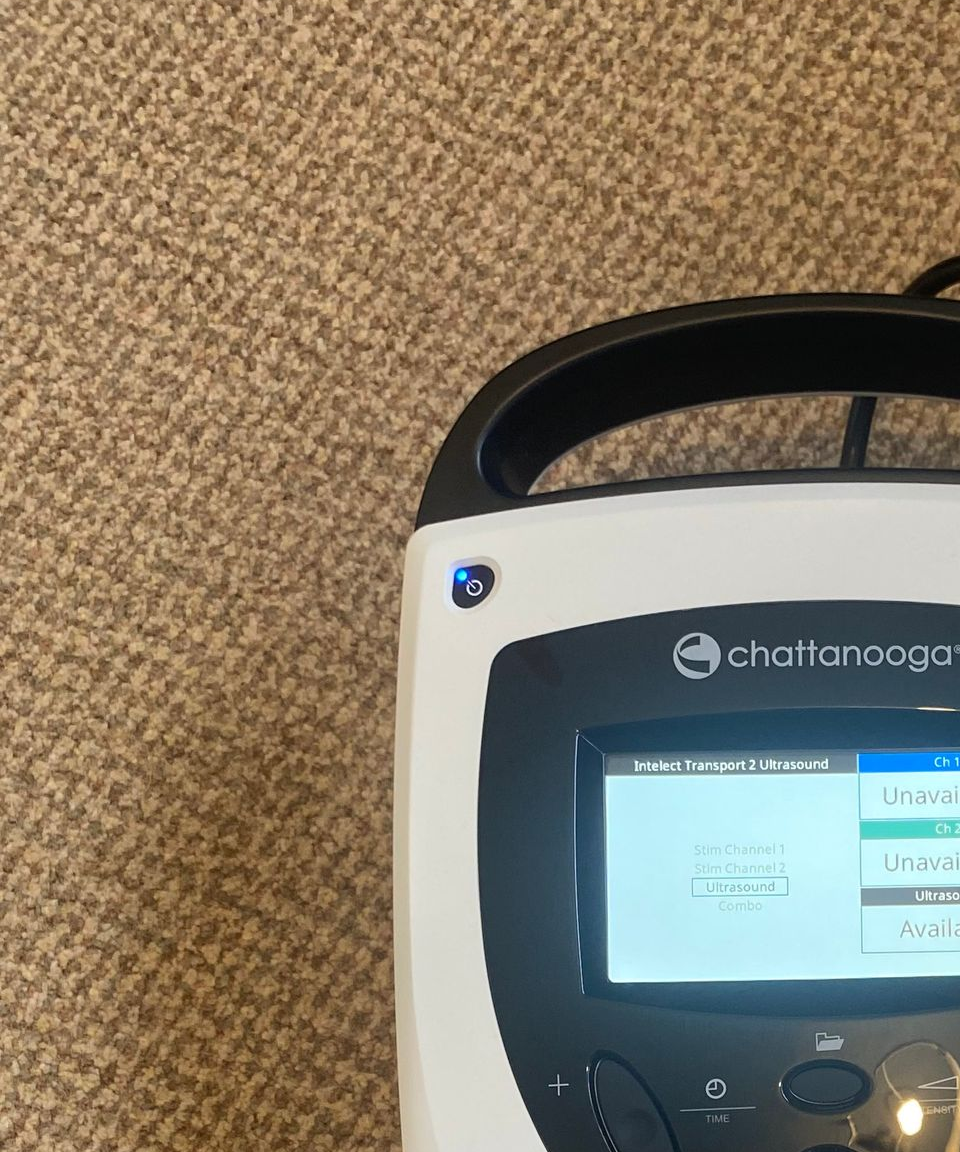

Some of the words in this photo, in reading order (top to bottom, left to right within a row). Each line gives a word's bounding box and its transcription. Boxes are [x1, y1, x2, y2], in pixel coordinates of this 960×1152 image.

[634, 759, 682, 772] Intelect
[684, 758, 747, 775] Transport
[748, 759, 757, 771] 2
[759, 757, 829, 771] Ultrasound
[934, 756, 950, 769] Ch
[953, 756, 960, 768] 1
[935, 822, 951, 835] Ch
[694, 843, 722, 856] Stim
[724, 842, 778, 855] Channel
[779, 843, 786, 855] 1
[694, 862, 722, 875] Stim
[724, 860, 777, 874] Channel
[778, 861, 787, 873] 2
[705, 879, 776, 893] Ultrasound
[718, 899, 763, 913] Combo
[705, 1114, 730, 1123] TIME
